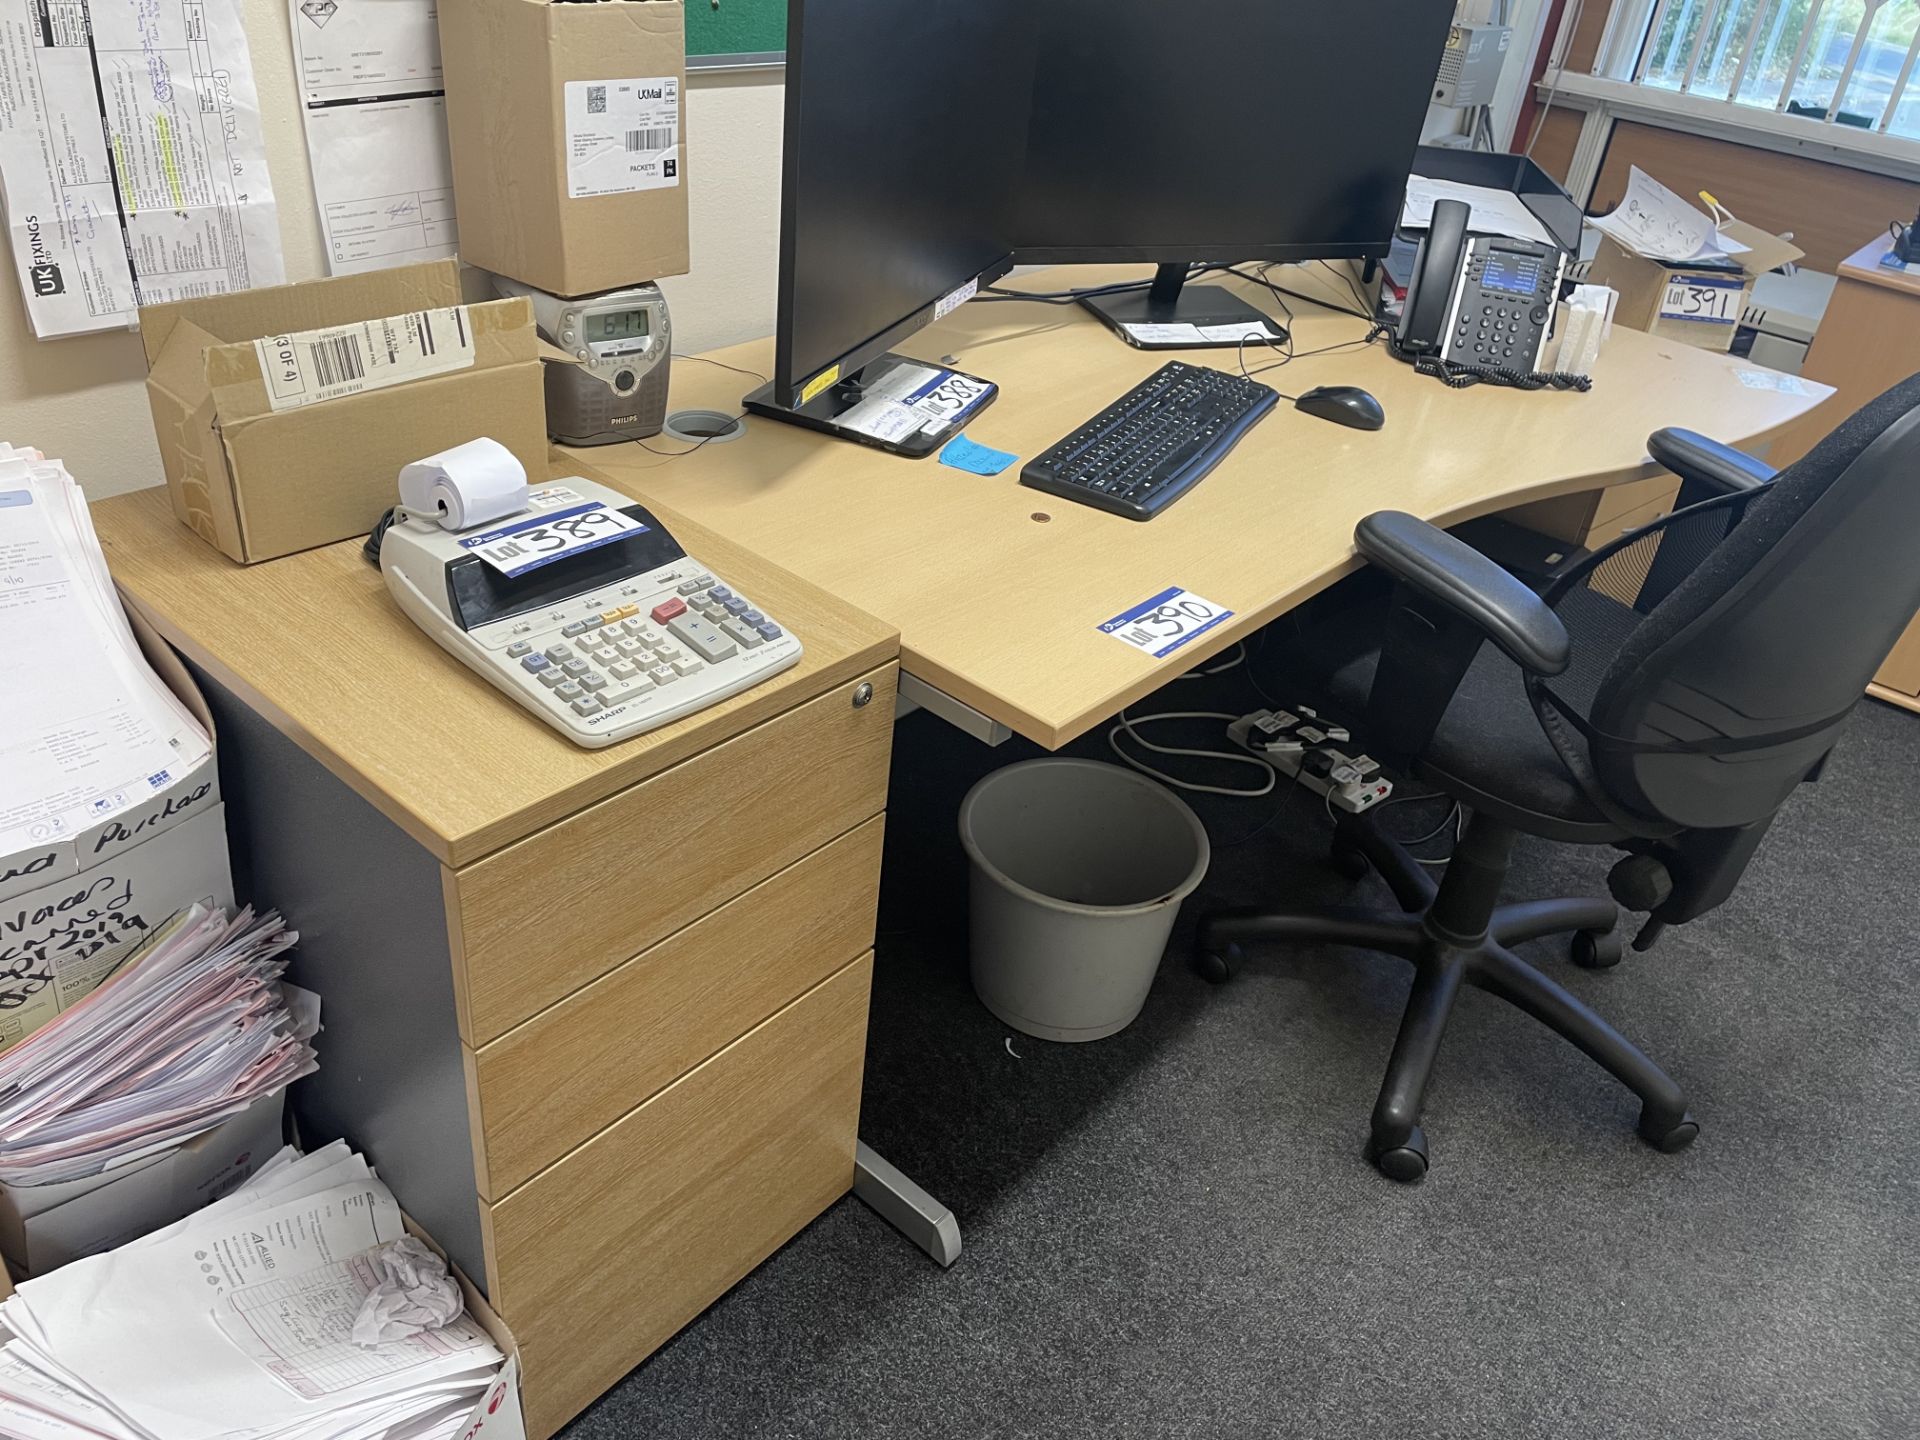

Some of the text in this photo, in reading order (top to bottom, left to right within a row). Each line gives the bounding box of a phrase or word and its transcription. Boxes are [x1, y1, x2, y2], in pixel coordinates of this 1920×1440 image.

[30, 0, 42, 37] Despatch
[629, 164, 656, 172] PACKETS
[26, 215, 56, 292] UK FIXINGS
[1667, 286, 1729, 318] Lot 391
[279, 350, 295, 368] OF
[283, 370, 299, 383] 4)
[921, 379, 983, 416] Lot 388
[611, 414, 638, 425] PHILIPS
[482, 512, 627, 563] Lot 389
[1120, 601, 1214, 647] Lot 390
[587, 706, 627, 726] SHARP
[0, 877, 115, 939] voices
[0, 879, 133, 961] canned
